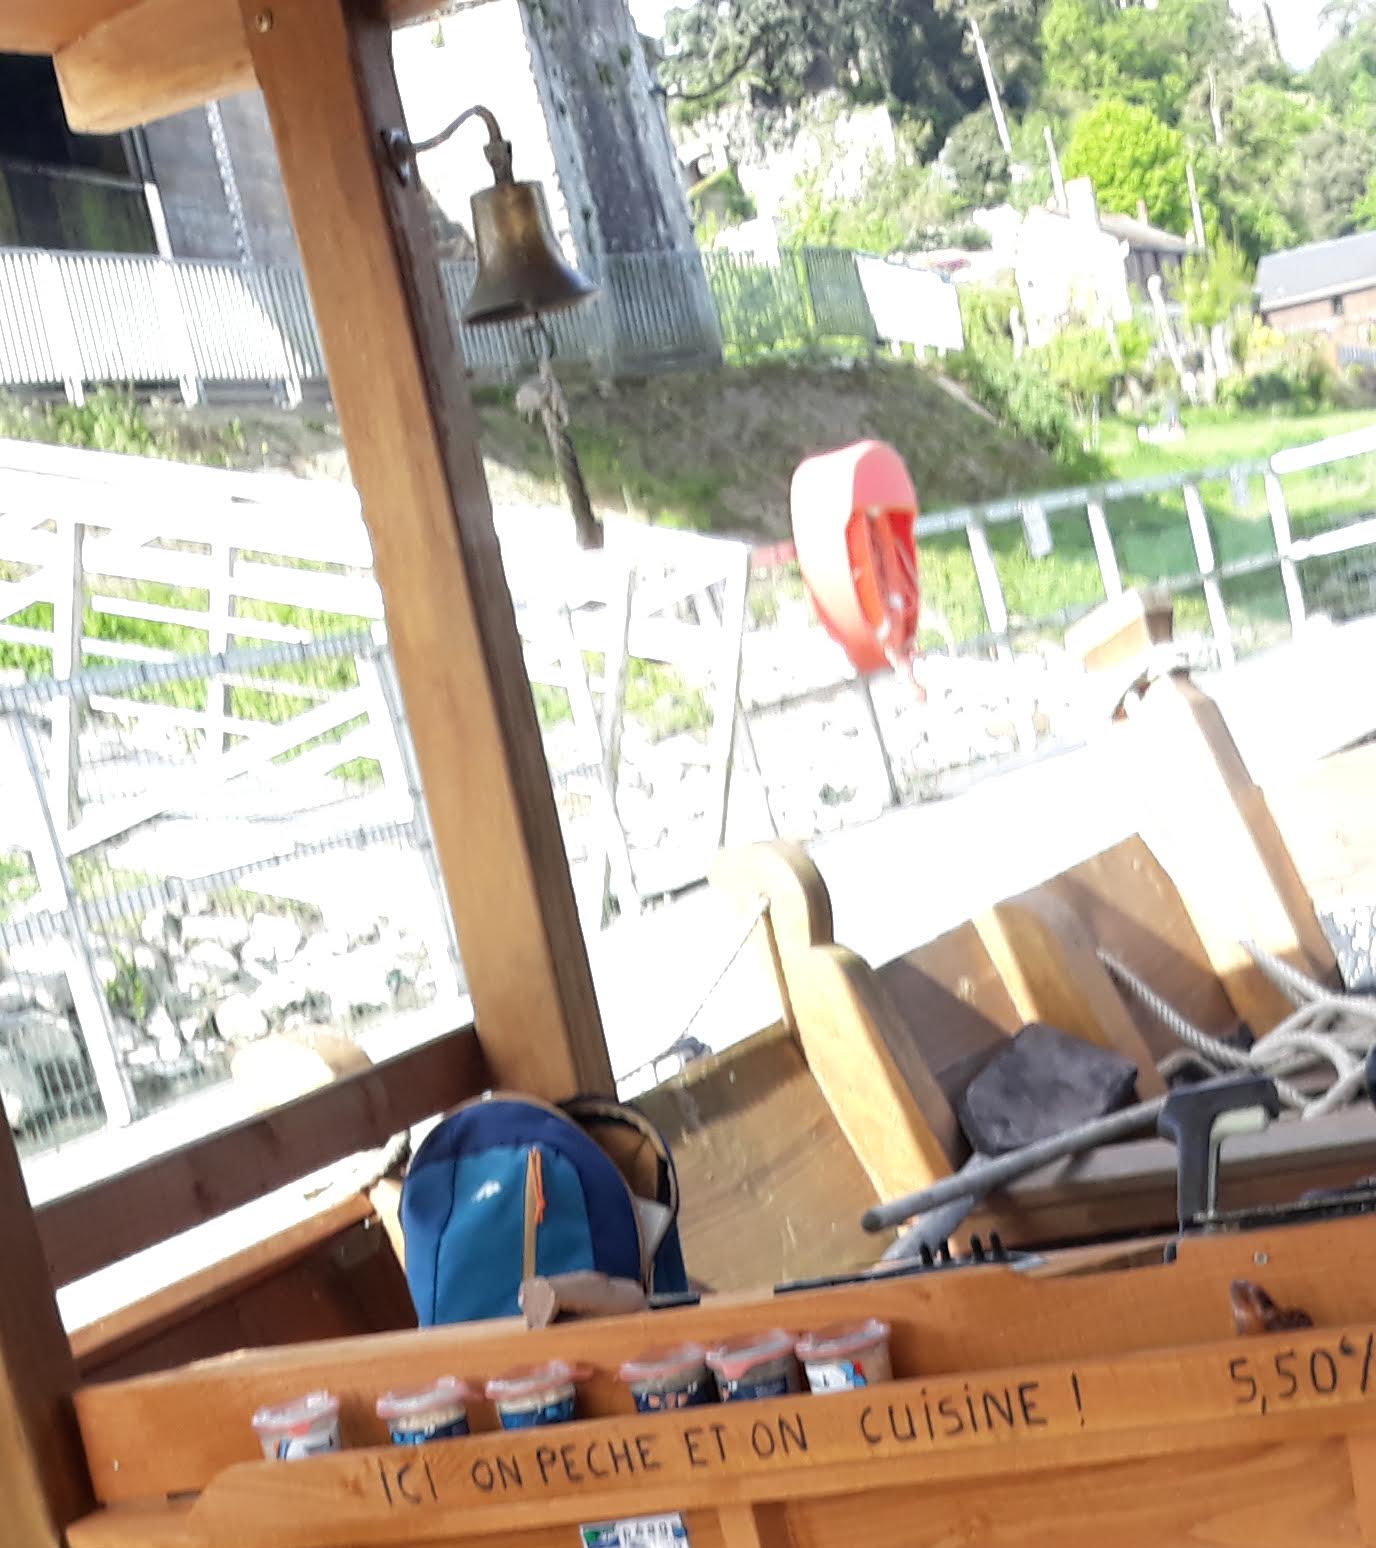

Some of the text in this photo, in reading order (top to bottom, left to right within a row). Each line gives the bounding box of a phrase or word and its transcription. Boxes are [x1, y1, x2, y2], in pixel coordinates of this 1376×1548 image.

[377, 1457, 439, 1506] ICI
[471, 1455, 523, 1492] ON
[535, 1433, 663, 1485] PECHE
[683, 1425, 726, 1467] ET
[751, 1413, 809, 1459] ON
